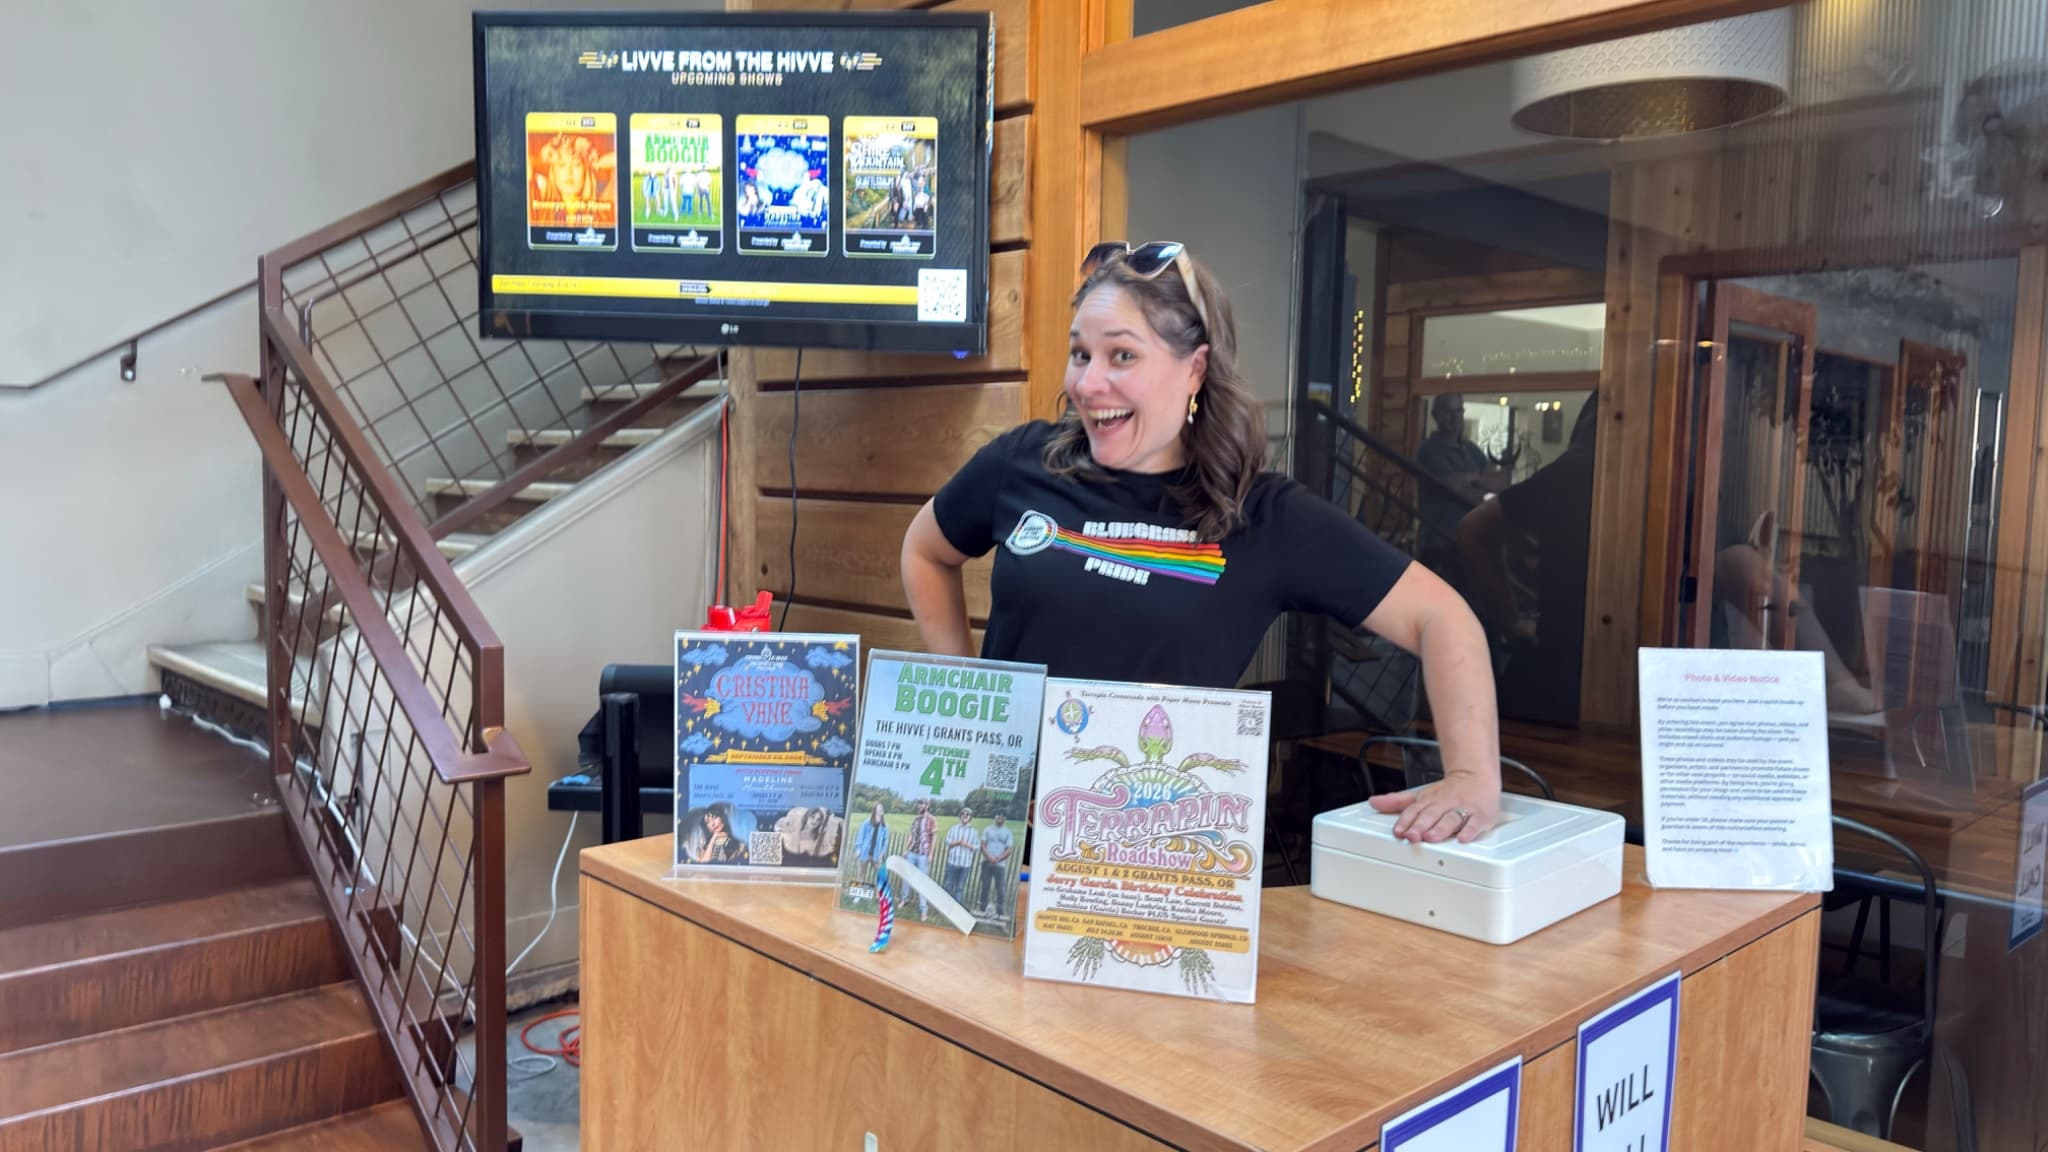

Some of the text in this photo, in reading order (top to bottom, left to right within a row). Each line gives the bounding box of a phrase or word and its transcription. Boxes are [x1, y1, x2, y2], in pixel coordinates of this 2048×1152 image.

[622, 51, 834, 73] LIVVE FROM THE HIVVE
[671, 72, 736, 86] UPCOMING
[1084, 557, 1151, 586] PRIDE
[716, 674, 809, 699] CRISTINA
[897, 663, 1014, 693] ARMCHAIR
[1684, 673, 1712, 683] Photo
[1723, 674, 1748, 684] Video
[1750, 675, 1780, 685] Notice
[742, 701, 793, 726] VANE
[895, 684, 1010, 722] BOOGIE
[876, 720, 893, 733] THE
[896, 722, 926, 737] HIVVE
[933, 726, 973, 743] GRANTS
[976, 729, 1005, 746] PASS,
[1008, 734, 1023, 748] OR
[923, 744, 970, 759] SEPTEMBER
[1134, 783, 1171, 801] 2026
[1040, 784, 1253, 857] TERRAPIN
[1107, 843, 1193, 868] Roadshow
[1046, 873, 1244, 902] Jerry Garcia Birthday Celebration
[1056, 863, 1234, 889] AUGUST 1 & 2 GRANTS PASS, OR
[1147, 910, 1168, 918] PLUS
[1597, 1064, 1654, 1132] WILL
